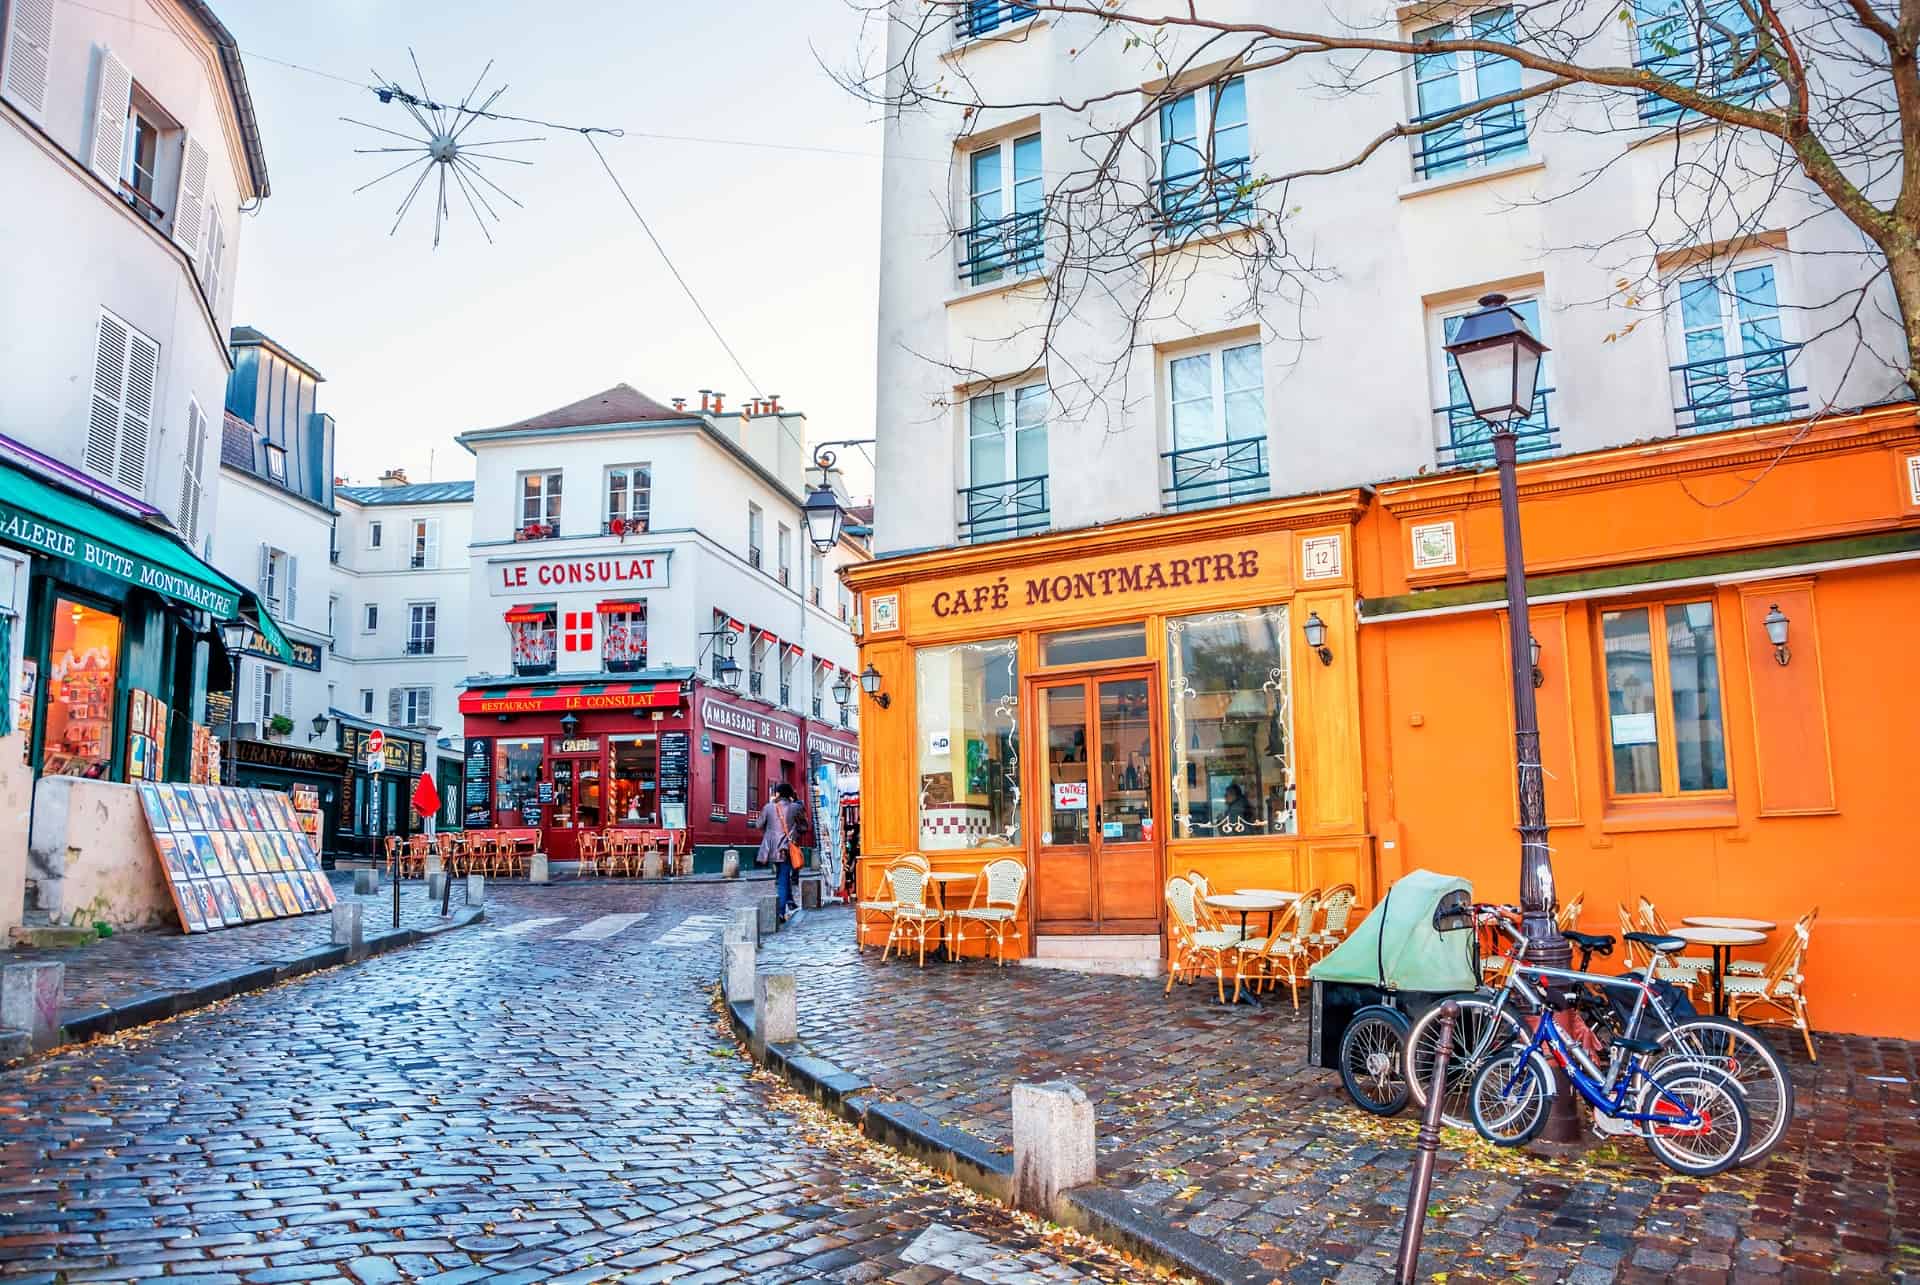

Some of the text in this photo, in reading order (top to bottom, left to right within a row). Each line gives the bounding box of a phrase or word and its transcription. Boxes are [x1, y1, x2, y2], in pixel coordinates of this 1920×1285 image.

[503, 559, 655, 588] LE CONSULAT
[1315, 551, 1329, 565] 12
[84, 543, 134, 578] BUTTE
[139, 566, 231, 614] MONTMARTRE
[931, 550, 1260, 617] CAFÉ MONTMARTRE
[481, 694, 656, 712] RESTAURANT LE CONSULAT
[707, 707, 798, 745] AMBASSADE DE SAVOIE
